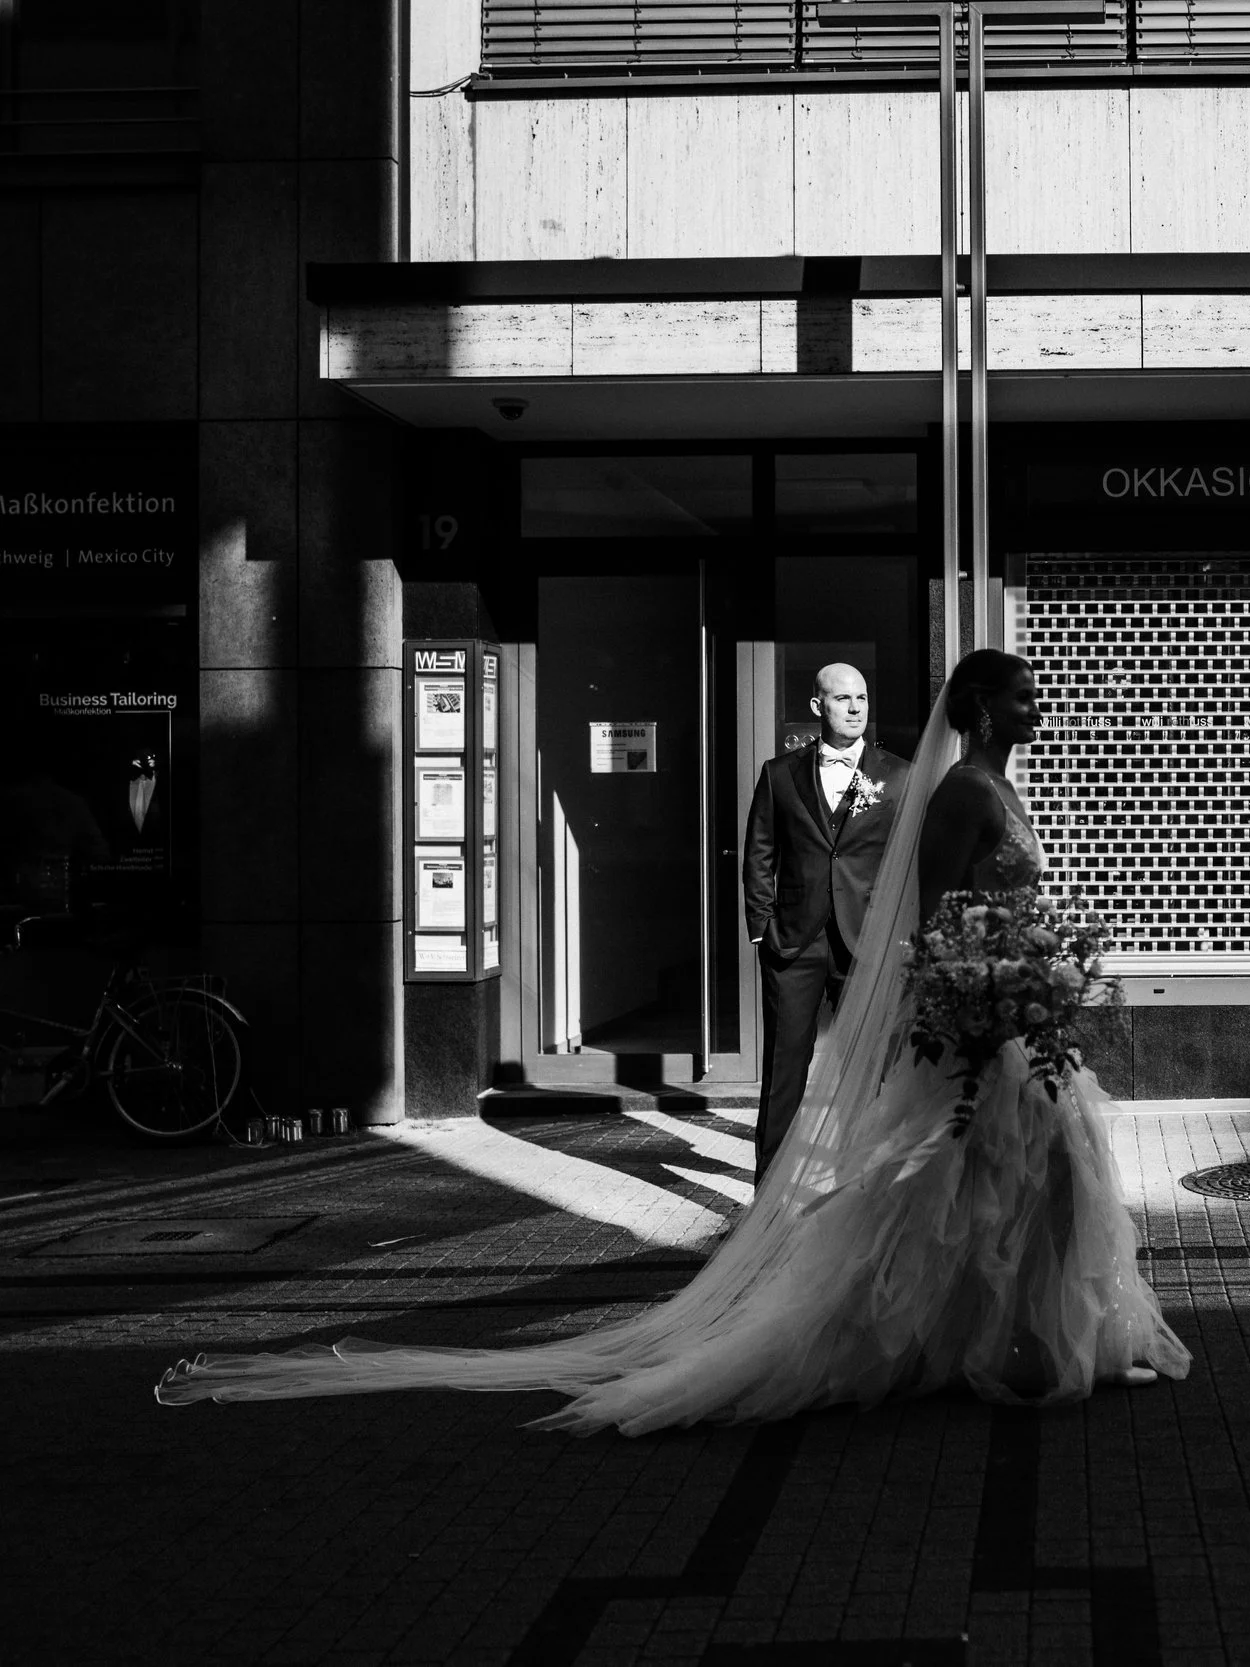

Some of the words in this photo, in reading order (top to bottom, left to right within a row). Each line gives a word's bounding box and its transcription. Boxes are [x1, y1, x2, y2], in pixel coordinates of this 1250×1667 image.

[417, 513, 460, 551] 19
[0, 549, 54, 568] hweig
[78, 549, 138, 564] Mexico
[142, 547, 175, 568] City
[39, 692, 108, 707] Business
[109, 692, 178, 709] Tailoring
[601, 728, 646, 738] SAMSUNG
